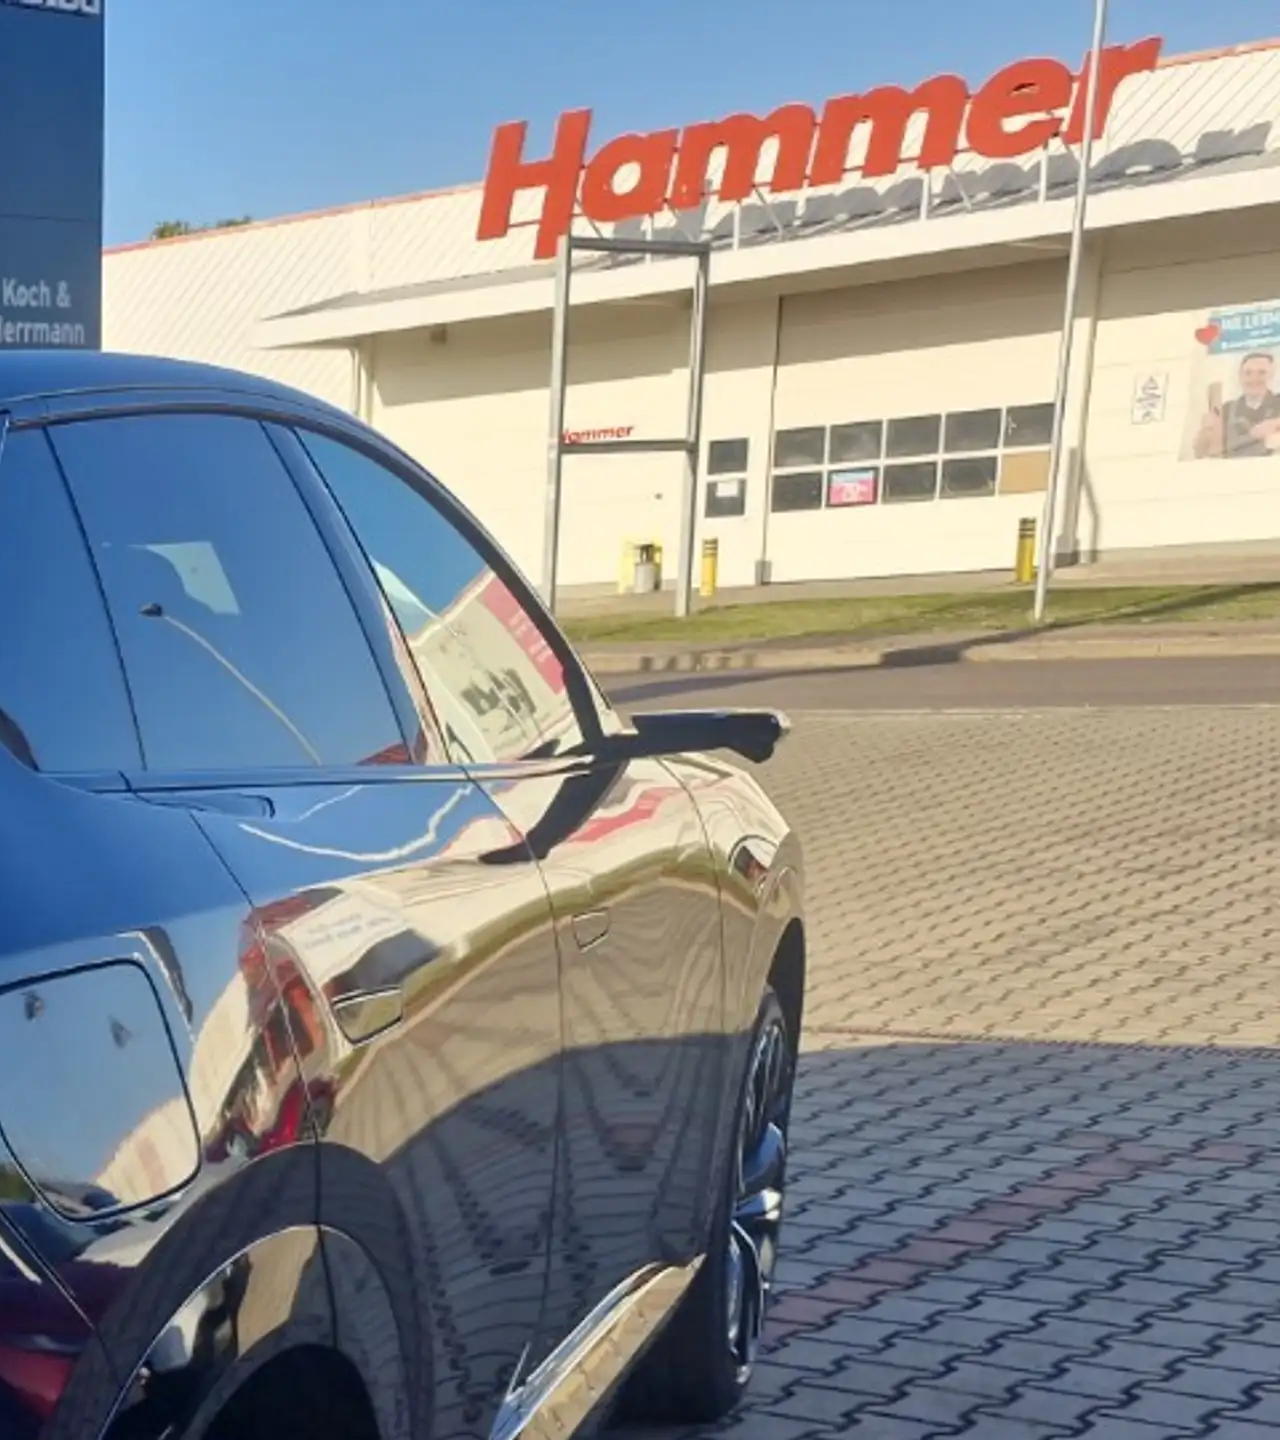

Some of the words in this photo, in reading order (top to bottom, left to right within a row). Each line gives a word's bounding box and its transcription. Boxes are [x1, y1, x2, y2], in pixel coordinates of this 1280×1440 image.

[476, 34, 1162, 260] Hammer
[2, 277, 51, 308] Koch
[55, 279, 72, 308] &
